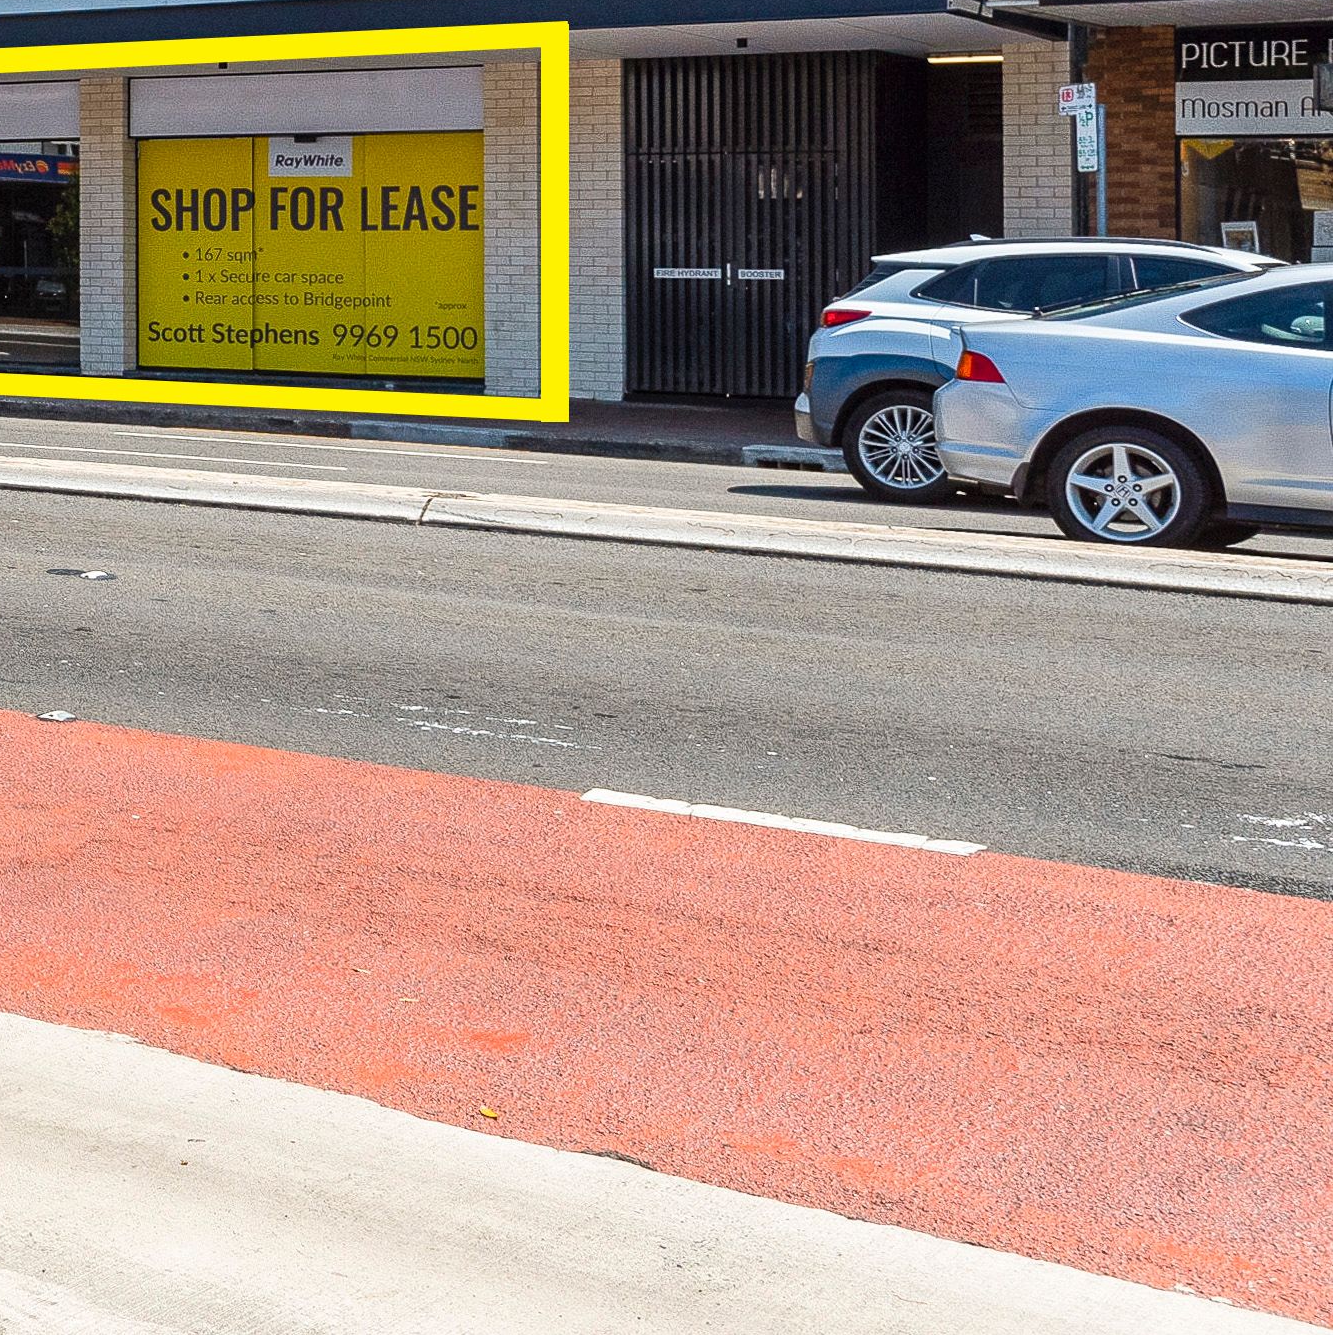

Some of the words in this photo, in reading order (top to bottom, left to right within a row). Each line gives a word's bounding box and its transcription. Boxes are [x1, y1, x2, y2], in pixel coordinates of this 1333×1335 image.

[1181, 39, 1308, 69] PICTURE
[1181, 97, 1288, 119] Mosman
[150, 187, 255, 232] SHOP
[270, 186, 344, 232] FOR
[361, 184, 480, 232] LEASE
[195, 248, 223, 262] 167
[196, 270, 203, 283] 1
[208, 273, 216, 283] x
[220, 269, 271, 283] Secure
[274, 273, 296, 283] car
[300, 272, 345, 288] space
[656, 269, 676, 277] FIRE
[678, 269, 719, 278] HYDRANT
[740, 270, 782, 278] BOOSTER
[195, 291, 229, 305] Rear
[231, 294, 280, 306] access
[283, 293, 299, 306] to
[304, 291, 392, 312] Bridgepoint
[148, 321, 205, 344] Scott
[211, 322, 320, 349] Stephens
[332, 324, 399, 348] 9969
[409, 325, 478, 351] 1500
[369, 354, 410, 363] Commercial
[430, 356, 455, 365] Sydney
